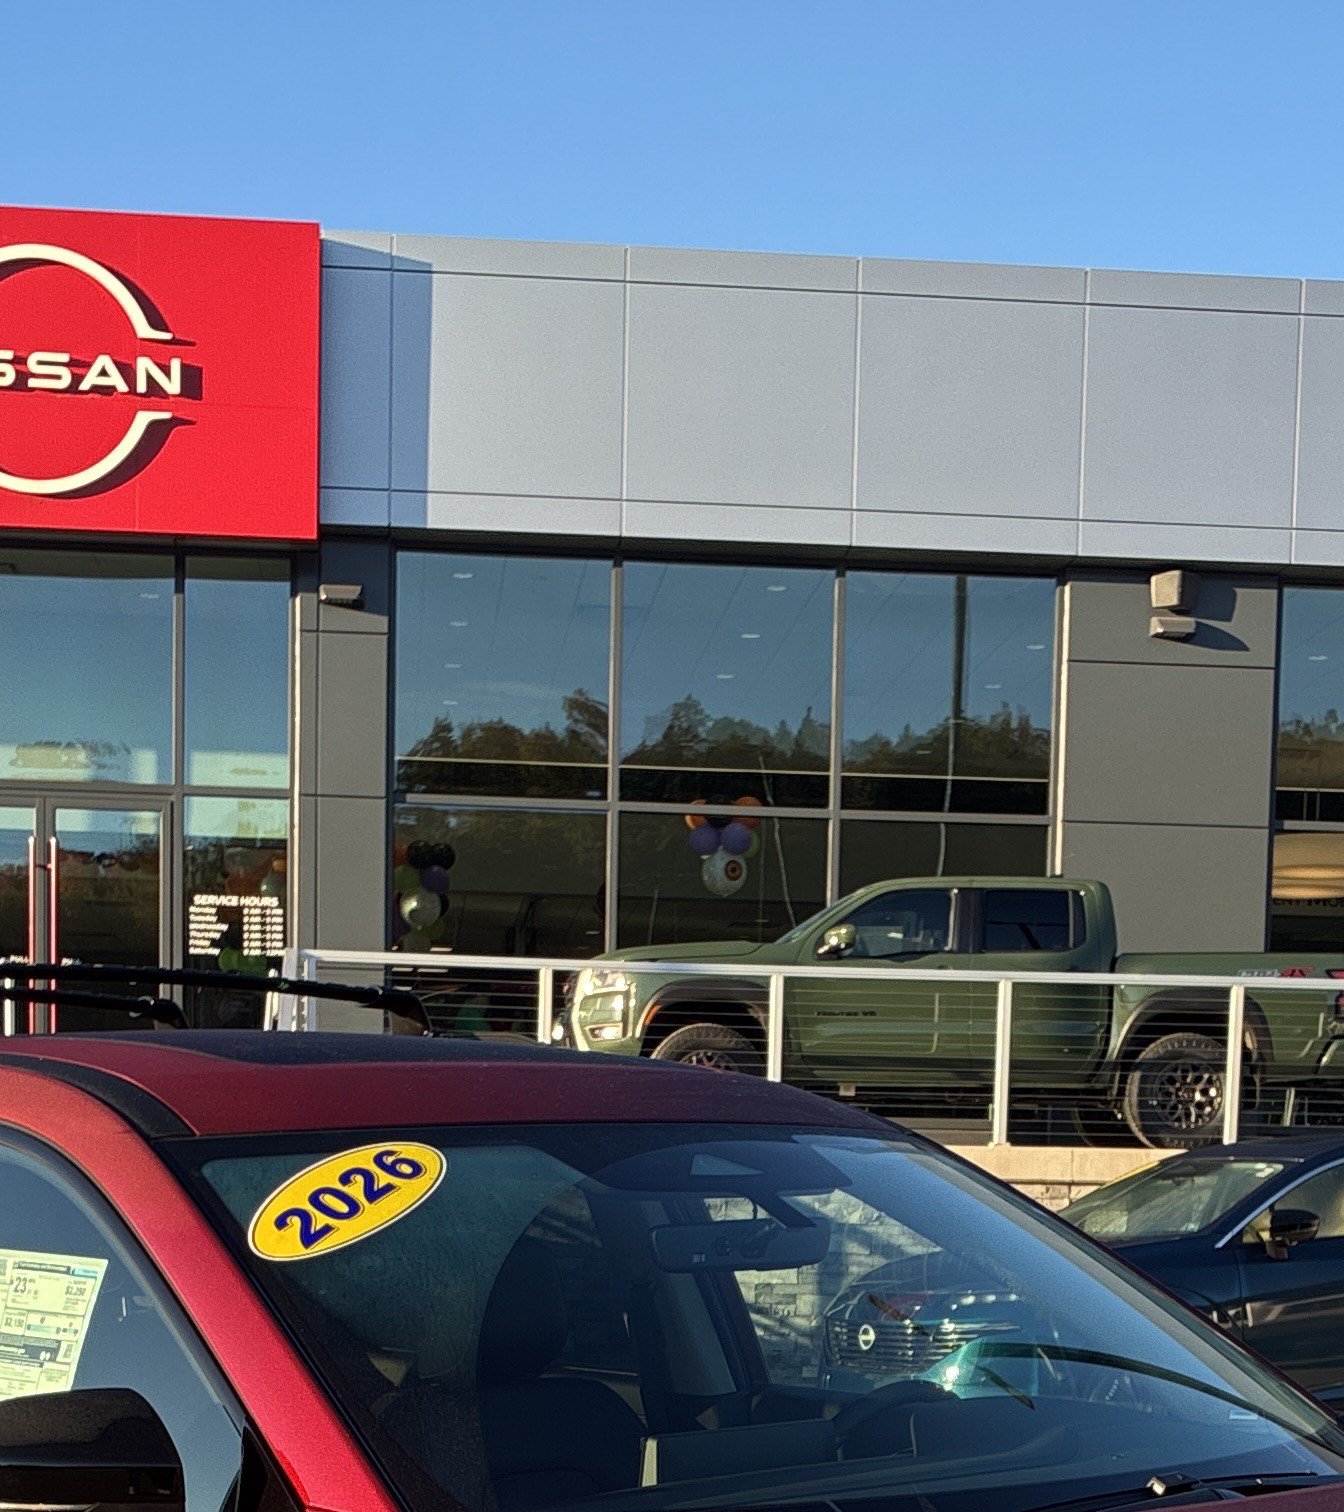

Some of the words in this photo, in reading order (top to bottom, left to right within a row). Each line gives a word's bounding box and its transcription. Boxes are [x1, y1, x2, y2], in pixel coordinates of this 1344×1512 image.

[193, 894, 239, 907] SERVICE
[240, 896, 280, 908] HOURS
[274, 1149, 426, 1250] 2026
